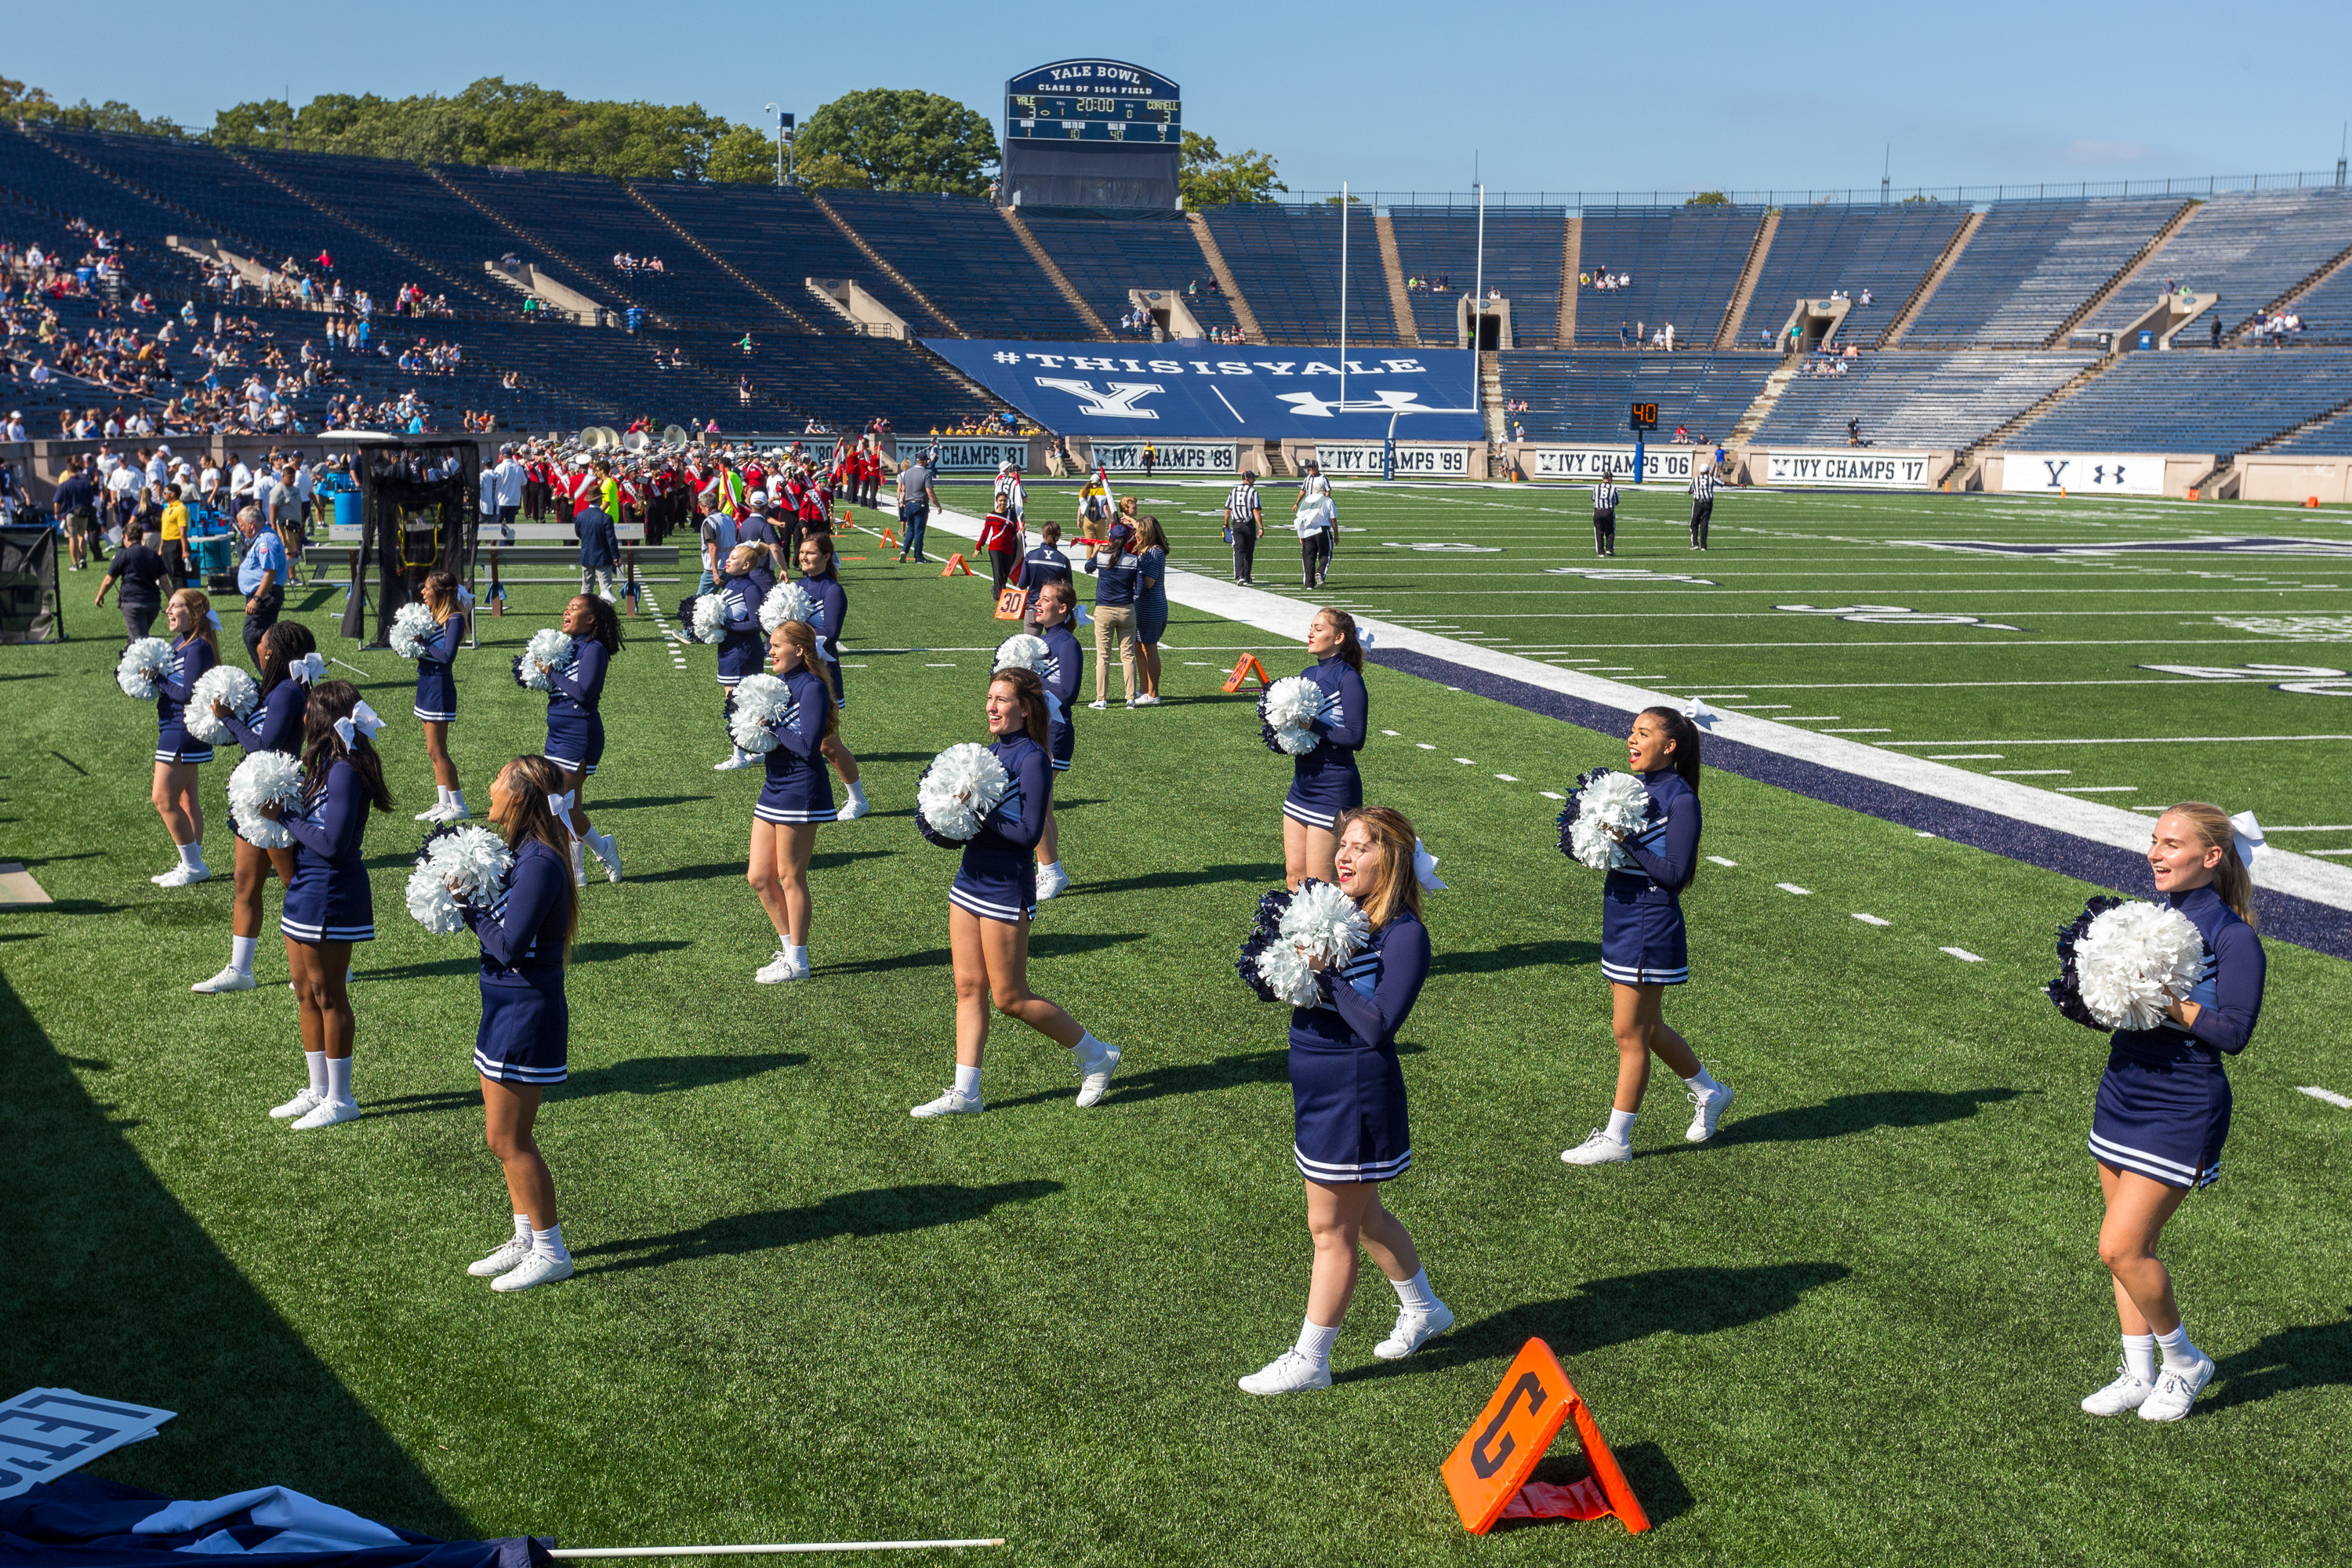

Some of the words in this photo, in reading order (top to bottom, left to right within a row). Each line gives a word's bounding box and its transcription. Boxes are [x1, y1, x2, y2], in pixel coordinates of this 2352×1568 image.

[1051, 66, 1091, 80] YALE
[1098, 67, 1141, 85] BOWL
[1016, 96, 1036, 106] YALE
[1076, 97, 1115, 112] 20:00
[1146, 100, 1178, 111] CORNELL
[1029, 106, 1036, 119] 3
[1127, 110, 1133, 118] 0
[1163, 111, 1171, 124] 3
[1070, 129, 1080, 140] 10
[1110, 130, 1123, 141] 40
[1160, 131, 1166, 143] 3
[993, 350, 1427, 376] #THISISYALE
[1034, 376, 1166, 419] Y
[1633, 404, 1657, 423] 40
[942, 445, 1000, 466] CHAMPS
[1004, 447, 1024, 466] '81
[1112, 448, 1137, 466] IVY
[1142, 449, 1205, 467] HAMPS
[1210, 449, 1232, 467] '89
[1337, 452, 1364, 469] IVY
[1440, 452, 1463, 470] '99
[1559, 454, 1586, 472] IVY
[1665, 456, 1690, 474] '06
[1794, 459, 1820, 477] IVY
[1826, 460, 1895, 480] CHAMPS
[1902, 463, 1924, 480] '17
[2043, 459, 2071, 488] Y
[1699, 478, 1708, 490] R
[1236, 491, 1247, 506] H
[1600, 487, 1609, 499] B
[1044, 550, 1054, 560] Y
[1000, 592, 1022, 613] 30
[1768, 604, 1987, 624] 30
[1470, 1370, 1548, 1480] G
